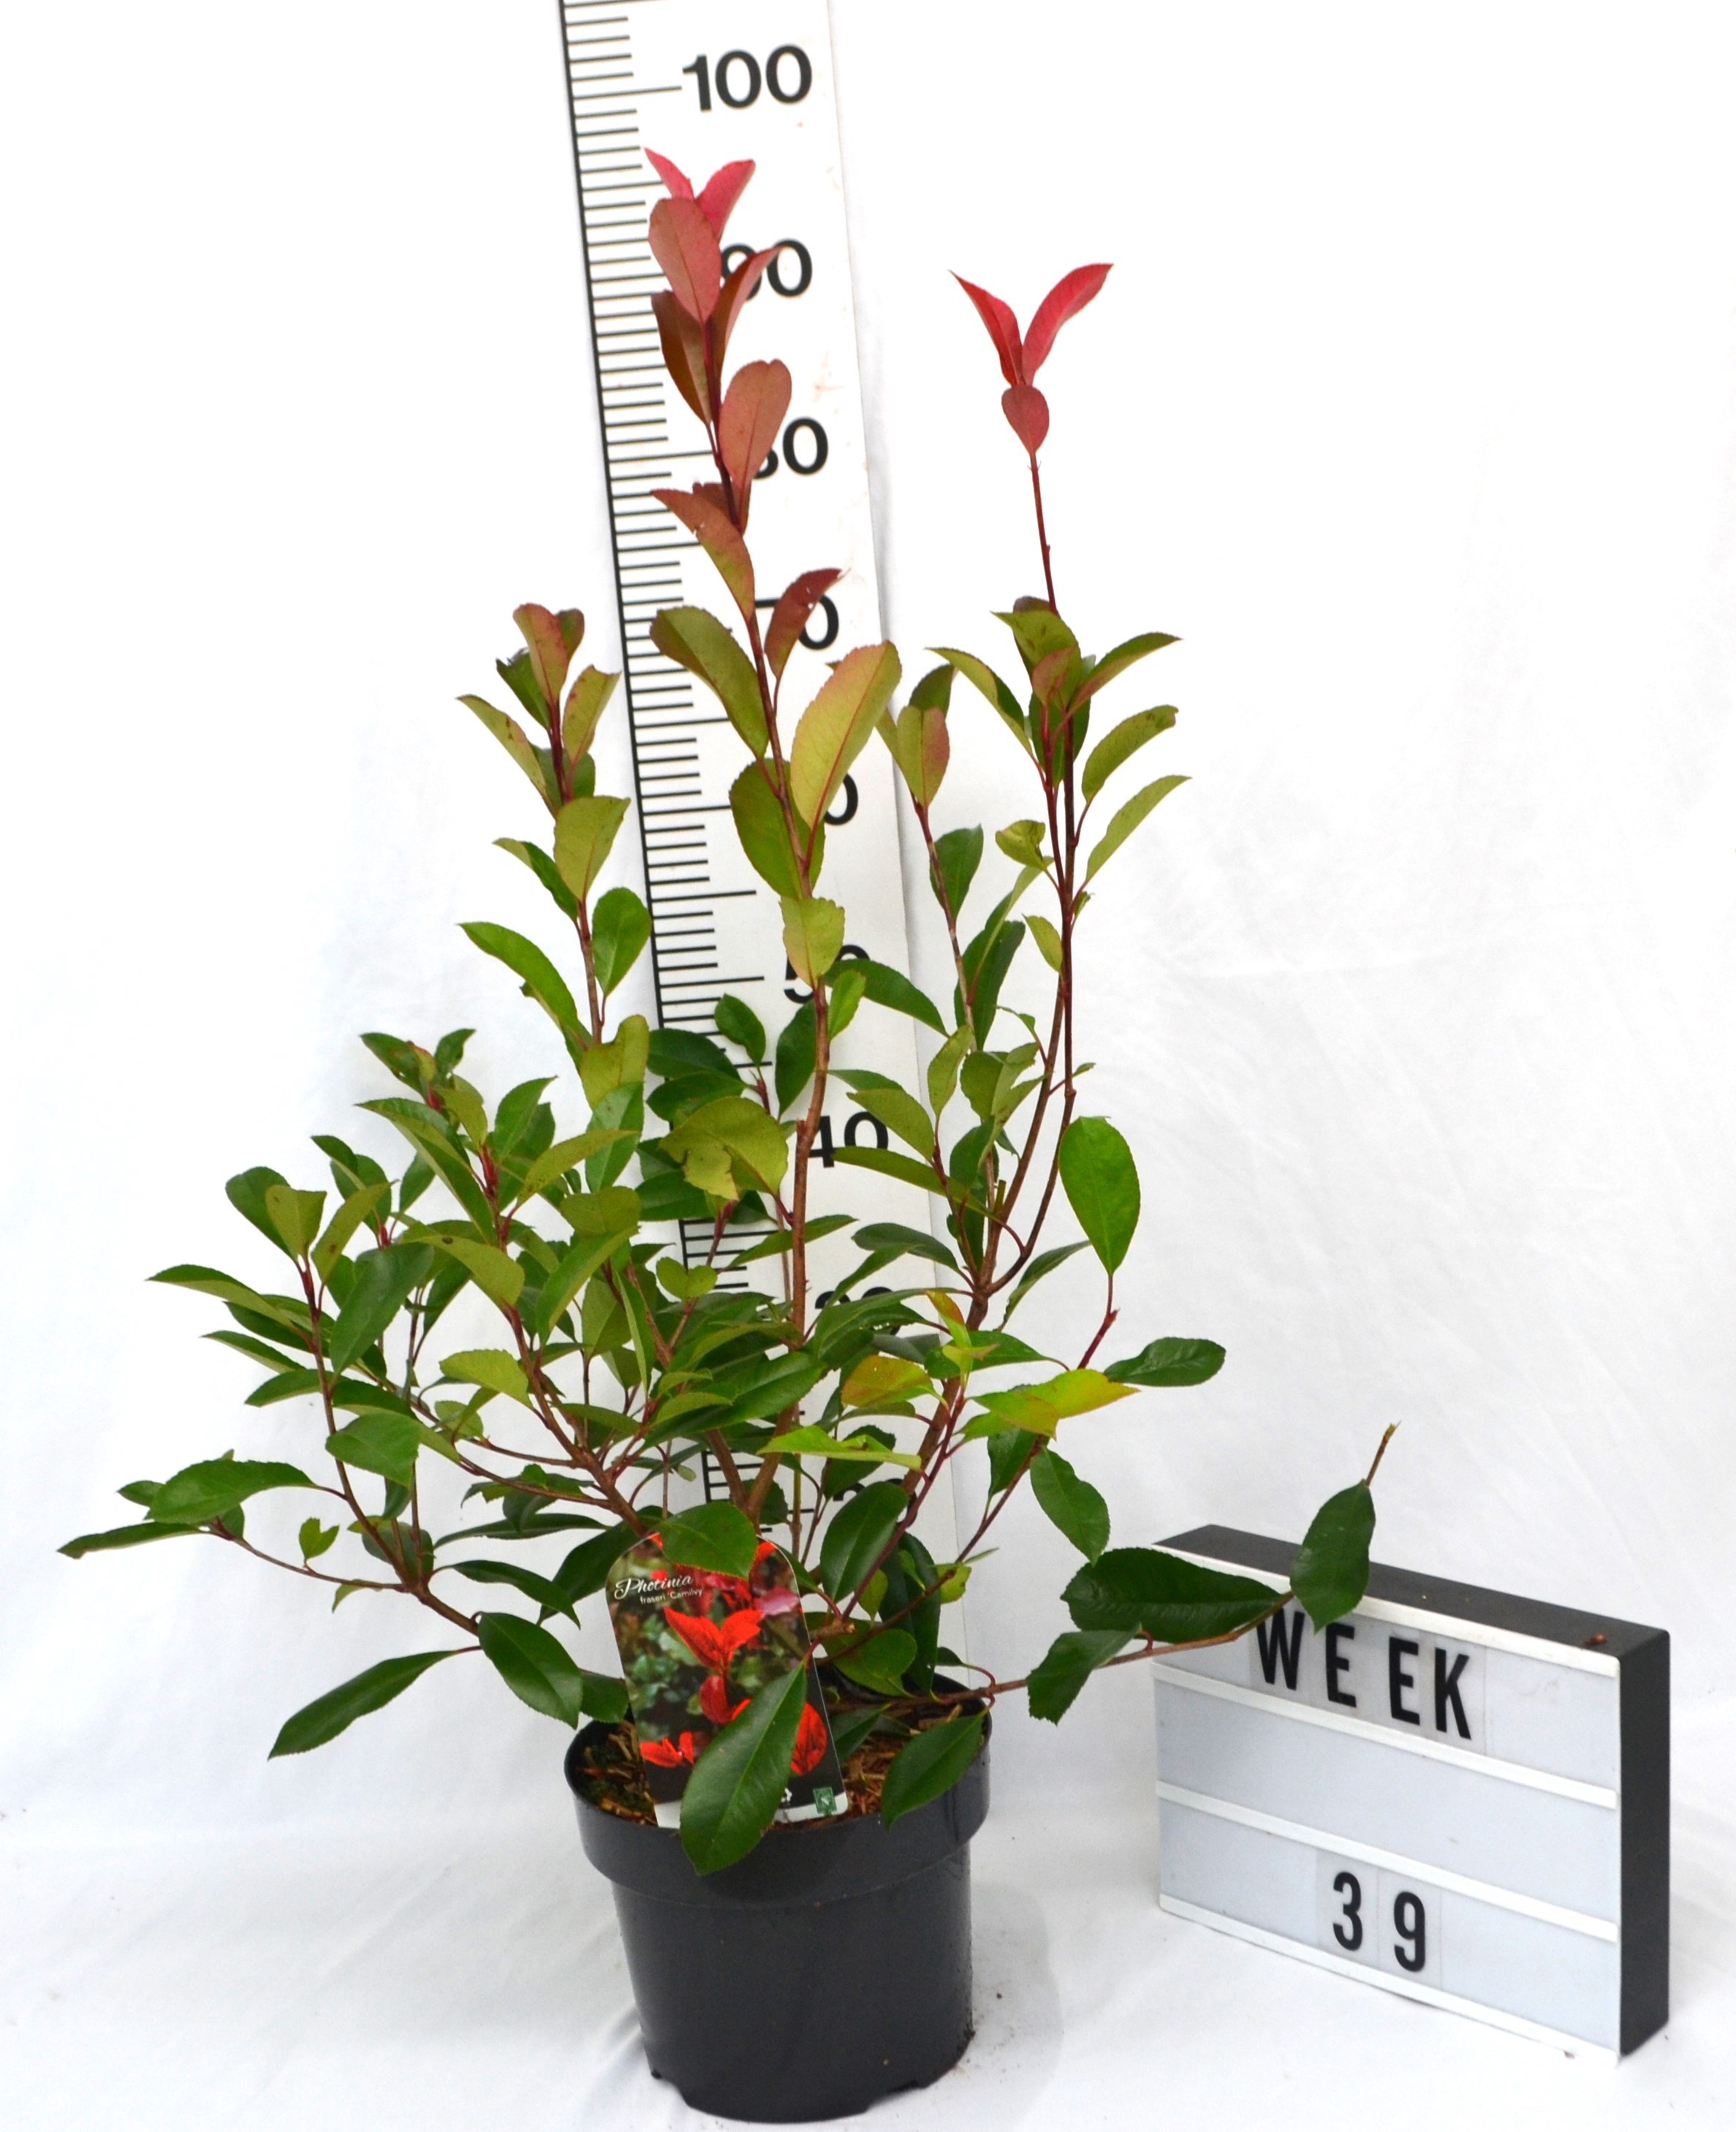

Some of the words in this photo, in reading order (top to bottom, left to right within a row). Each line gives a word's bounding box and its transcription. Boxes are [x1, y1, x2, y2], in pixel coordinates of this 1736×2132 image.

[682, 44, 812, 112] 100
[751, 417, 828, 479] 0
[754, 594, 839, 650] 0
[614, 1576, 692, 1600] Photinia
[1256, 1606, 1472, 1741] WEEK
[1332, 1871, 1426, 1973] 39
